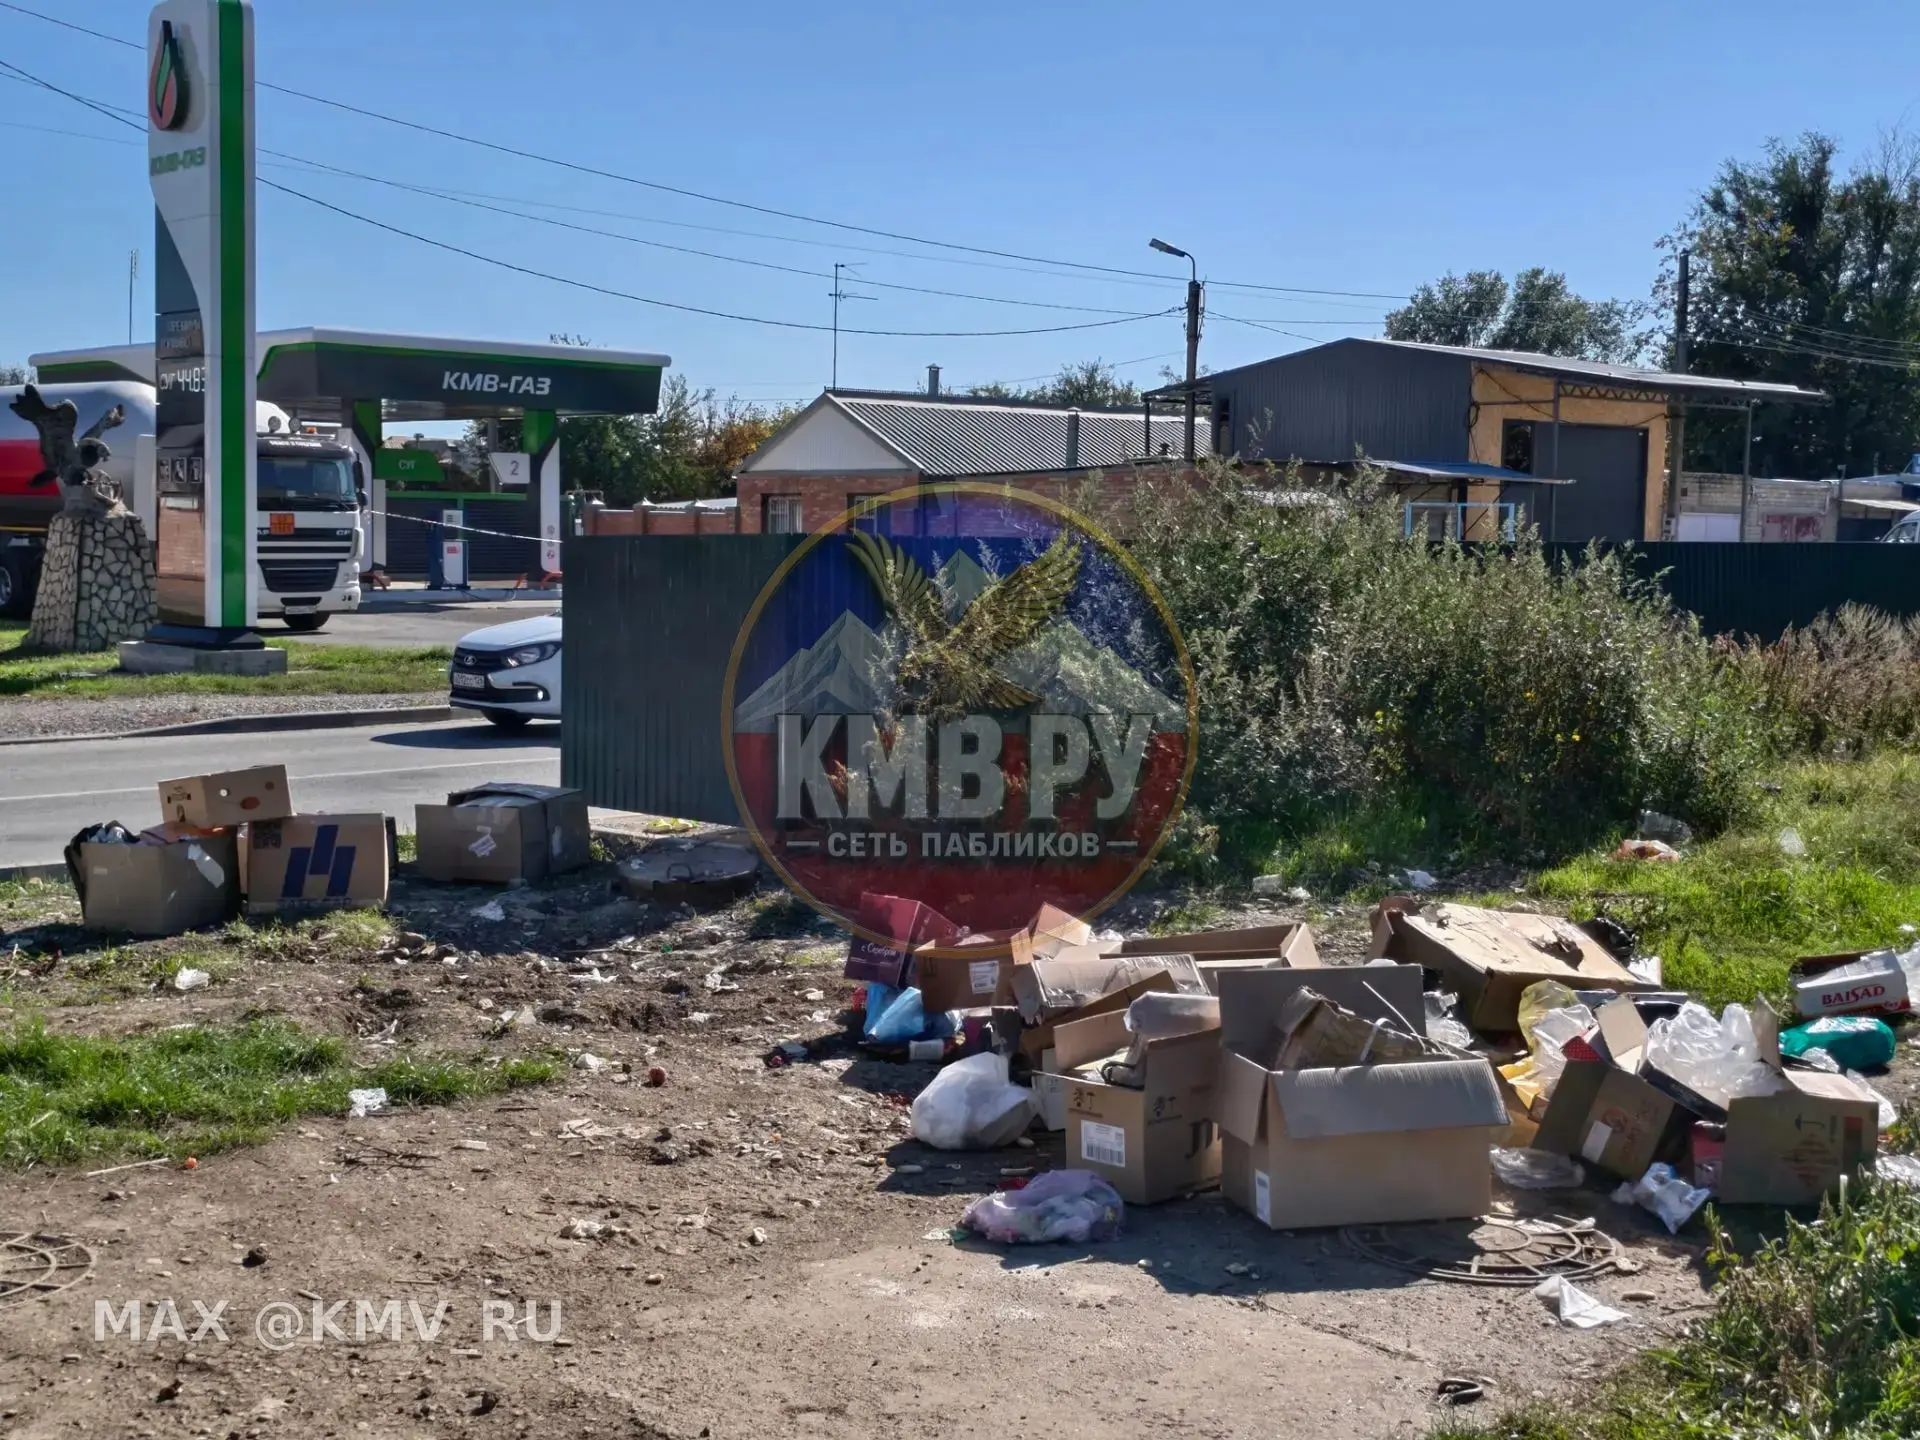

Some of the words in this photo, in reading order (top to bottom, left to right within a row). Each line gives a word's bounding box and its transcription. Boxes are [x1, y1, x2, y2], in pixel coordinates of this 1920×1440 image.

[442, 371, 551, 395] КМВ-ГАЗ
[510, 460, 520, 476] 2
[1822, 985, 1885, 1006] BAISAD
